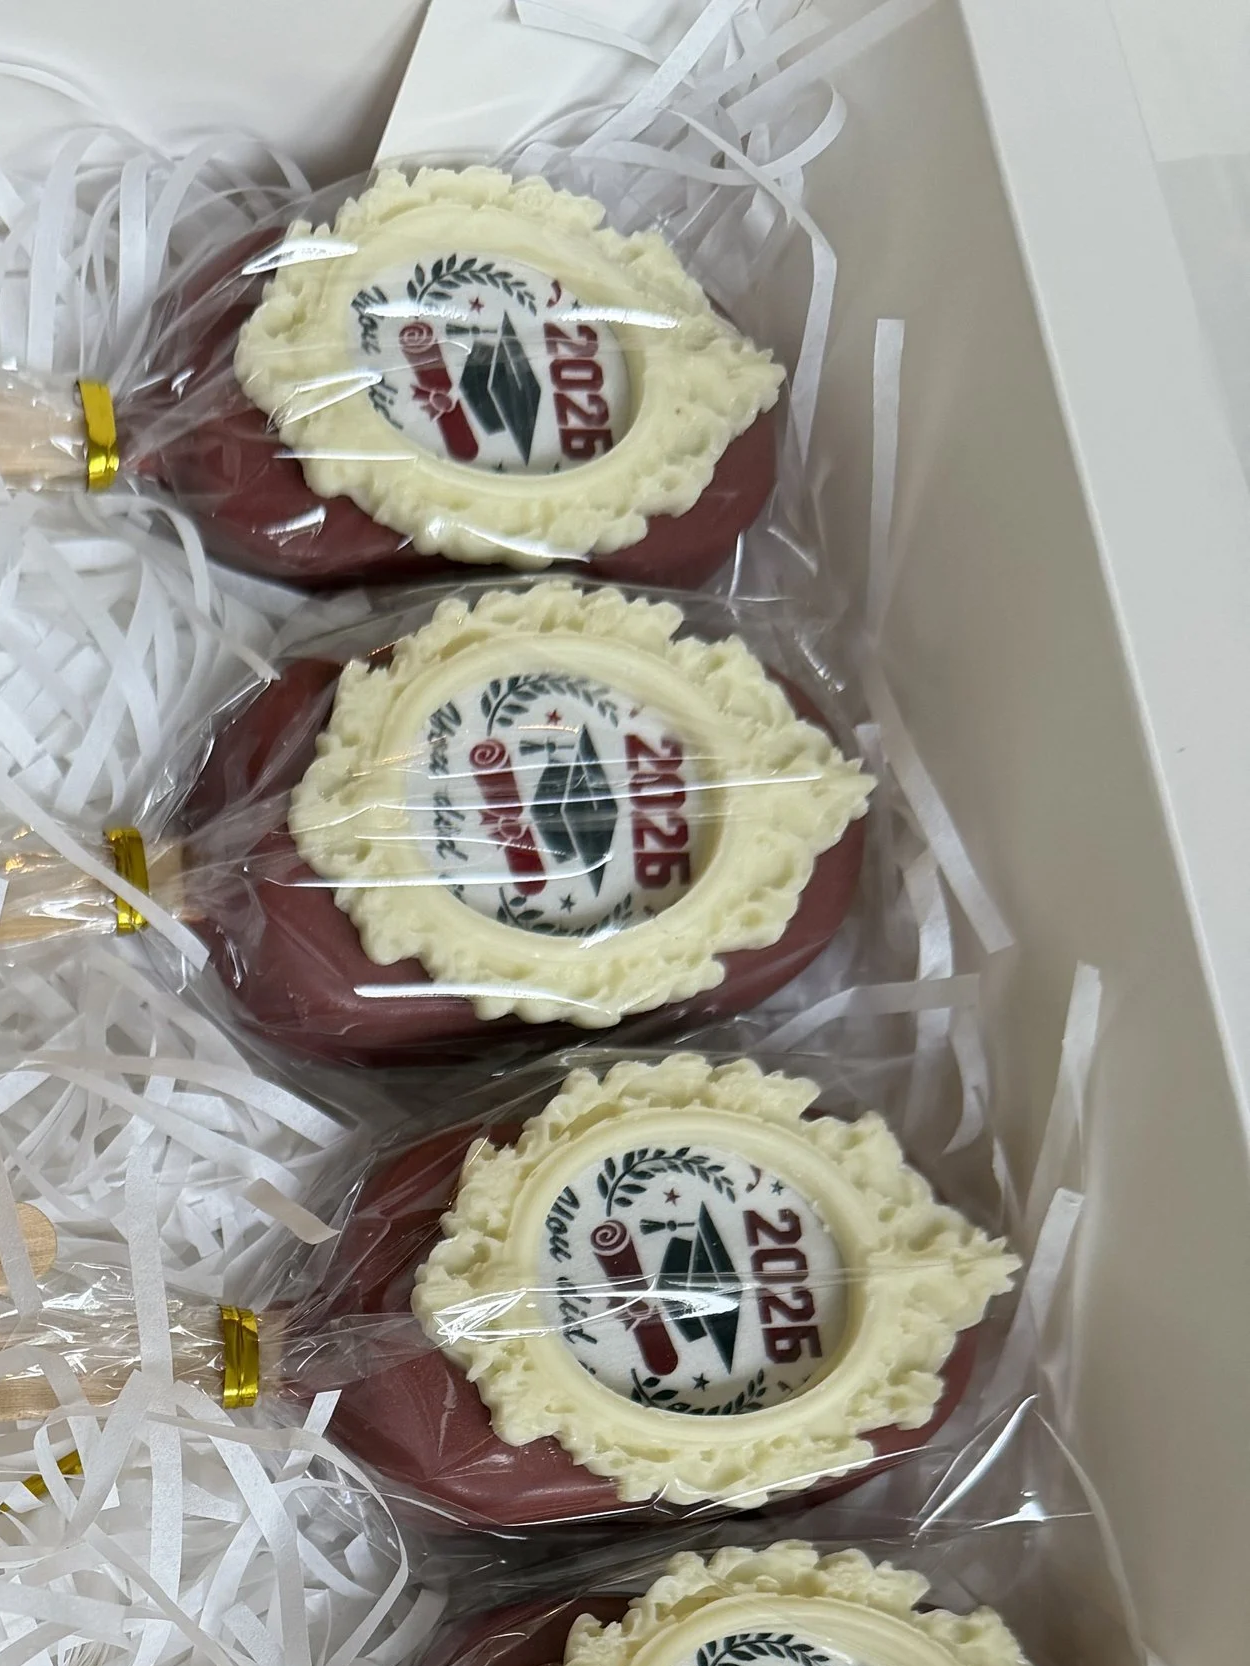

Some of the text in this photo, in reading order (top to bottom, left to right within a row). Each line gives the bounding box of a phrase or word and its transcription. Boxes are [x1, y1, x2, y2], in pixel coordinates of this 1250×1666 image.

[544, 322, 613, 460] 2026
[625, 735, 690, 890] 2026
[545, 1186, 580, 1262] You
[743, 1210, 822, 1363] 2026
[557, 1277, 597, 1344] did
